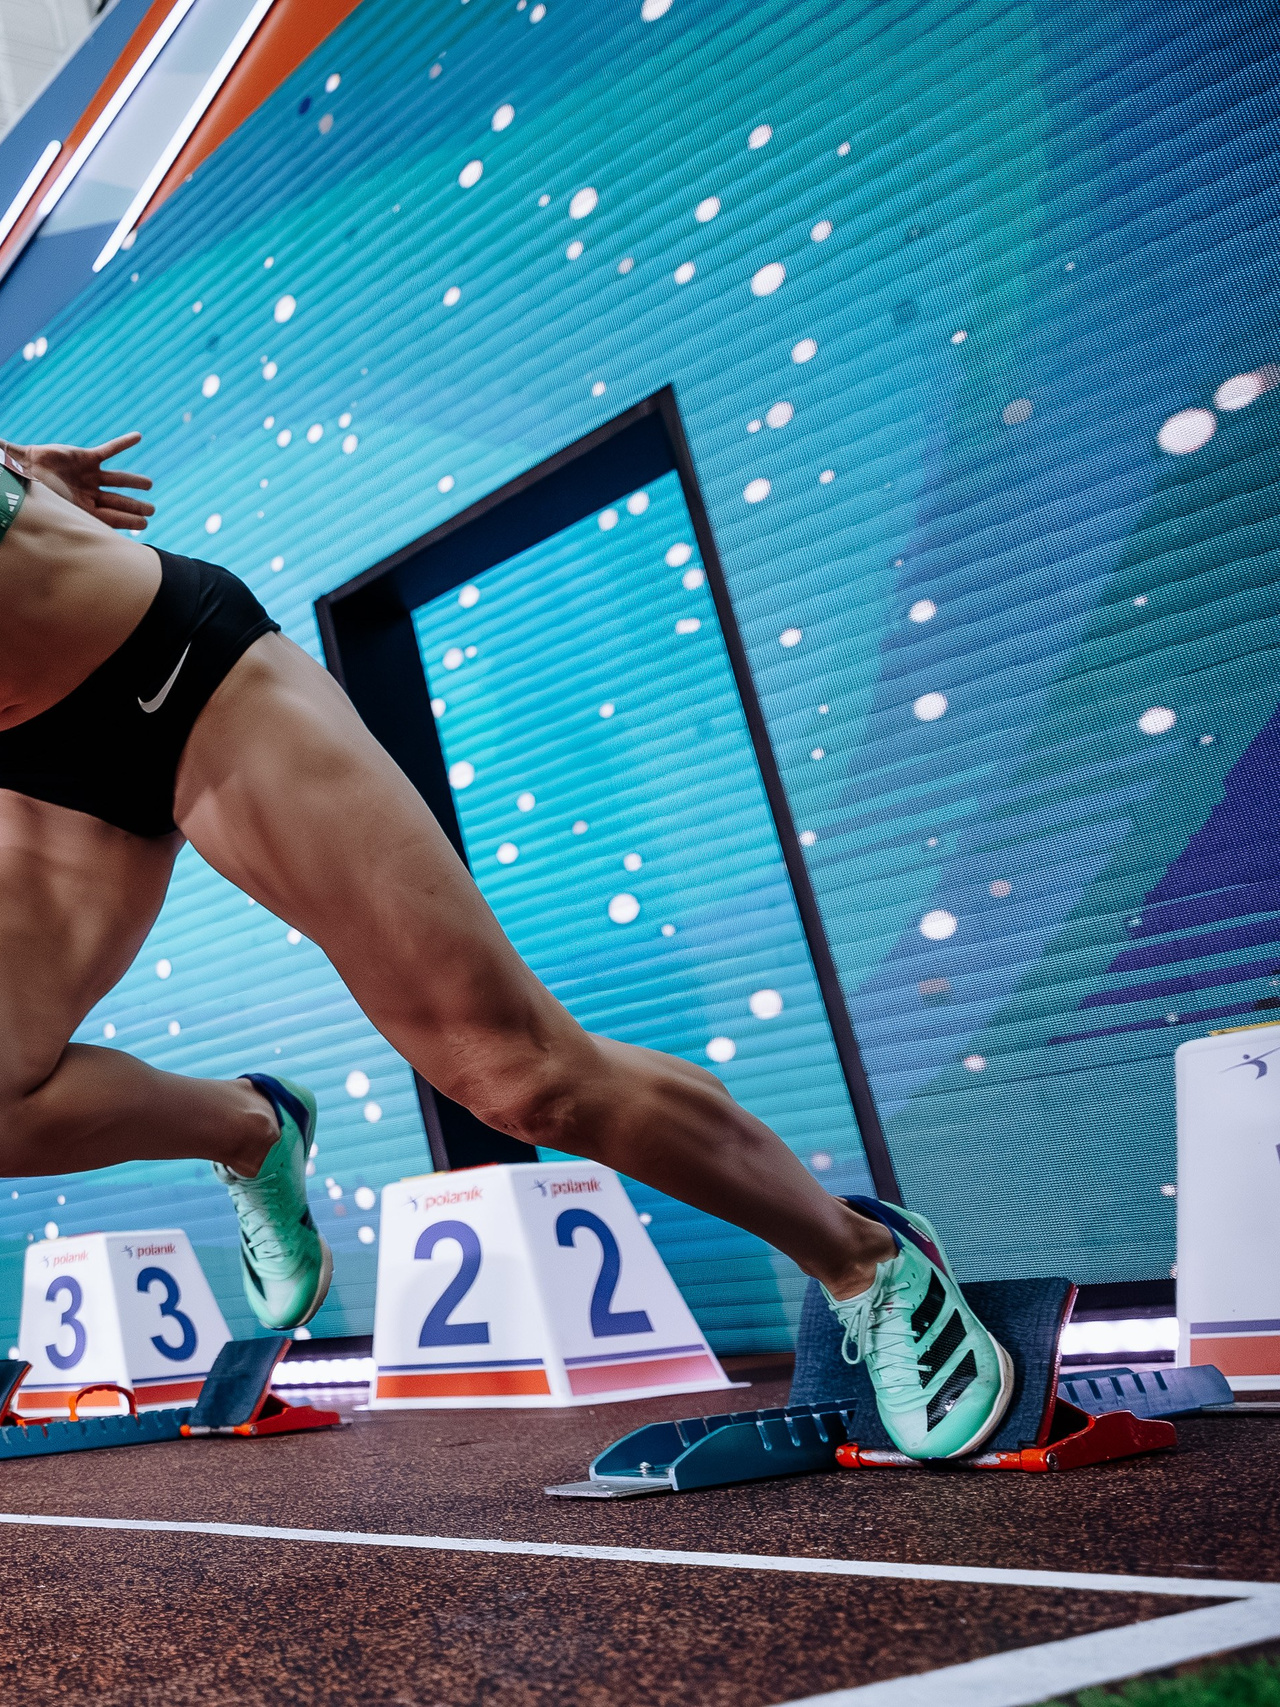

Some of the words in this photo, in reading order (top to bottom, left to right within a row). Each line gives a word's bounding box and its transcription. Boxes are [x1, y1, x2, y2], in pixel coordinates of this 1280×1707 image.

[425, 1185, 483, 1210] polanik
[550, 1176, 602, 1198] polanik
[53, 1250, 89, 1267] polanik
[137, 1243, 177, 1260] polanik
[555, 1208, 654, 1338] 2
[414, 1220, 490, 1347] 2
[45, 1276, 87, 1370] 3
[136, 1267, 198, 1362] 3
